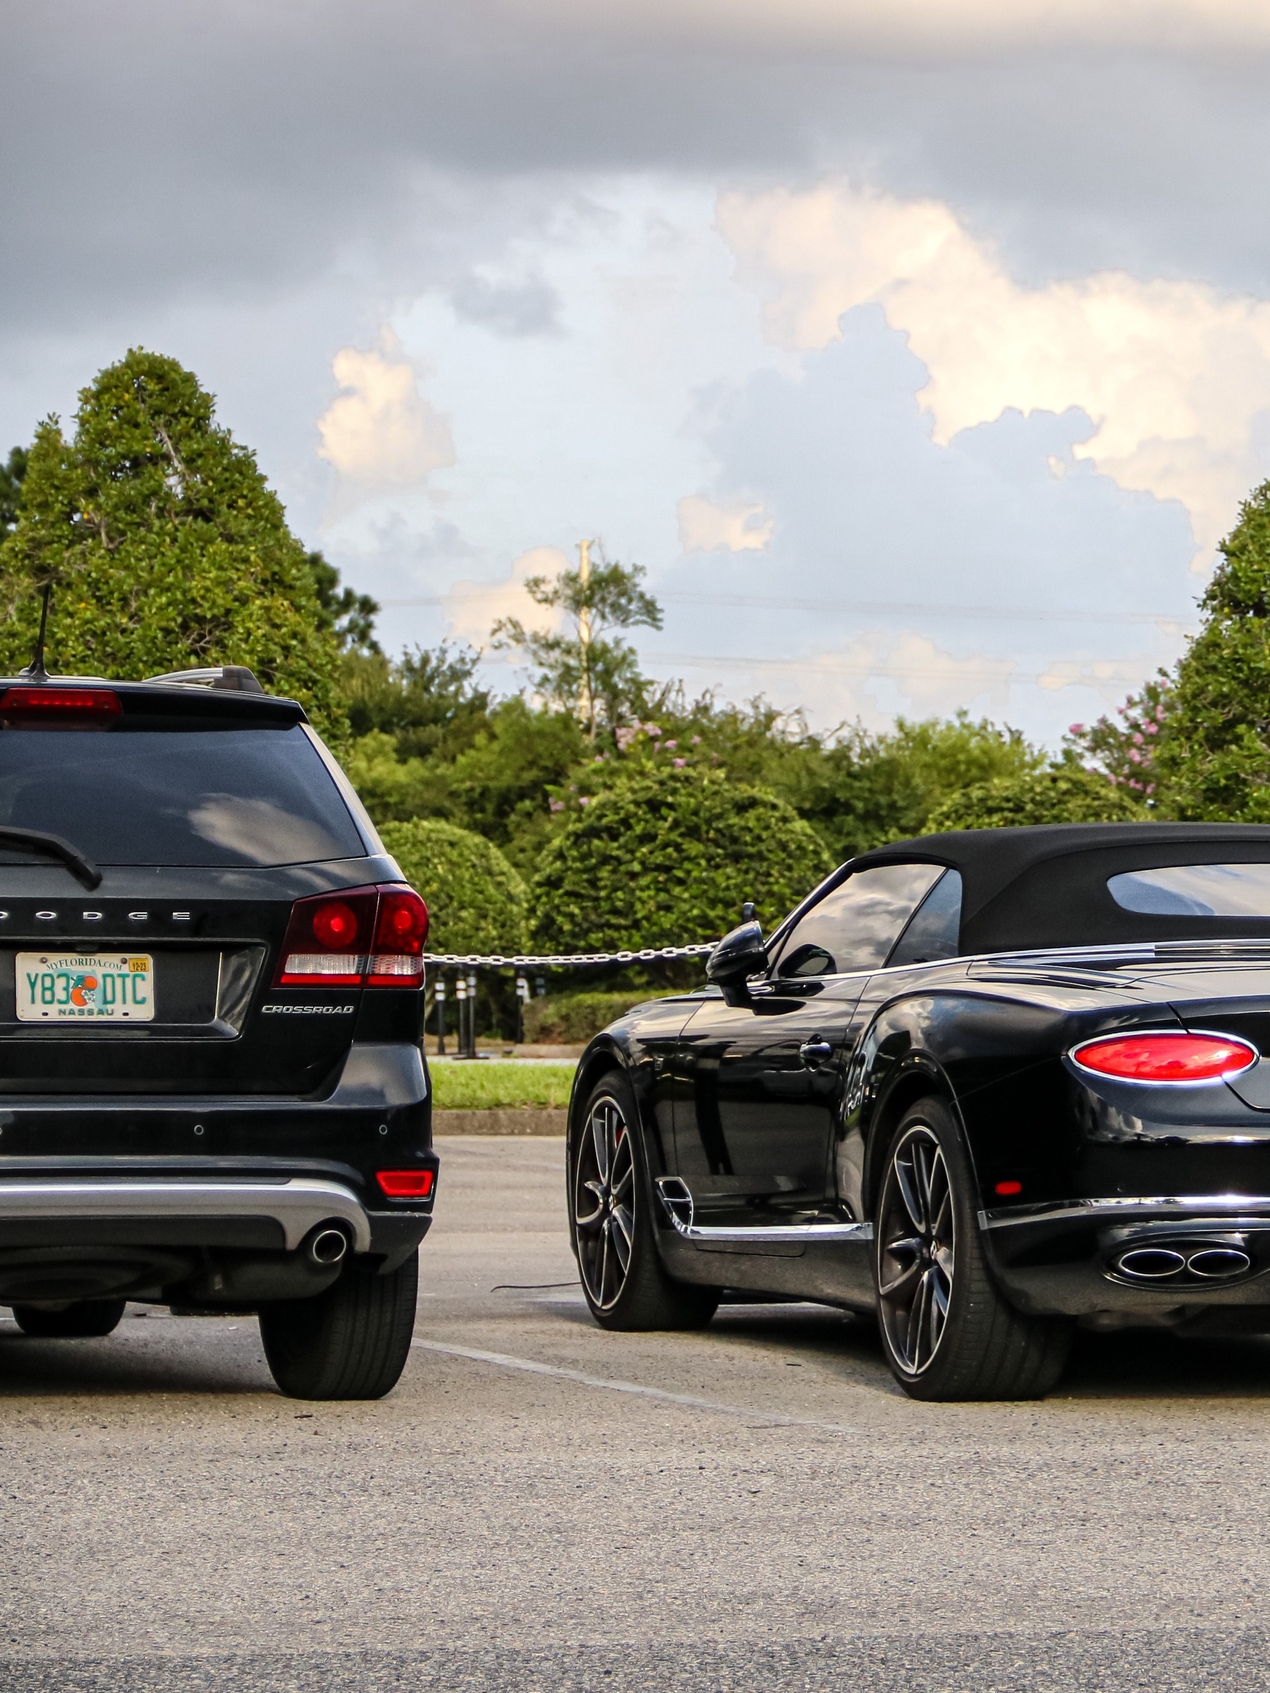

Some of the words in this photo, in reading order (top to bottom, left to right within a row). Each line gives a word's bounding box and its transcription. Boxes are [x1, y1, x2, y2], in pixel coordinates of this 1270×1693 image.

[46, 958, 122, 971] MYFLORIDA.COM
[26, 973, 70, 1004] Y83
[102, 973, 146, 1005] DTC
[58, 1008, 114, 1016] NASSAU
[261, 1005, 354, 1014] CROSSROAD
